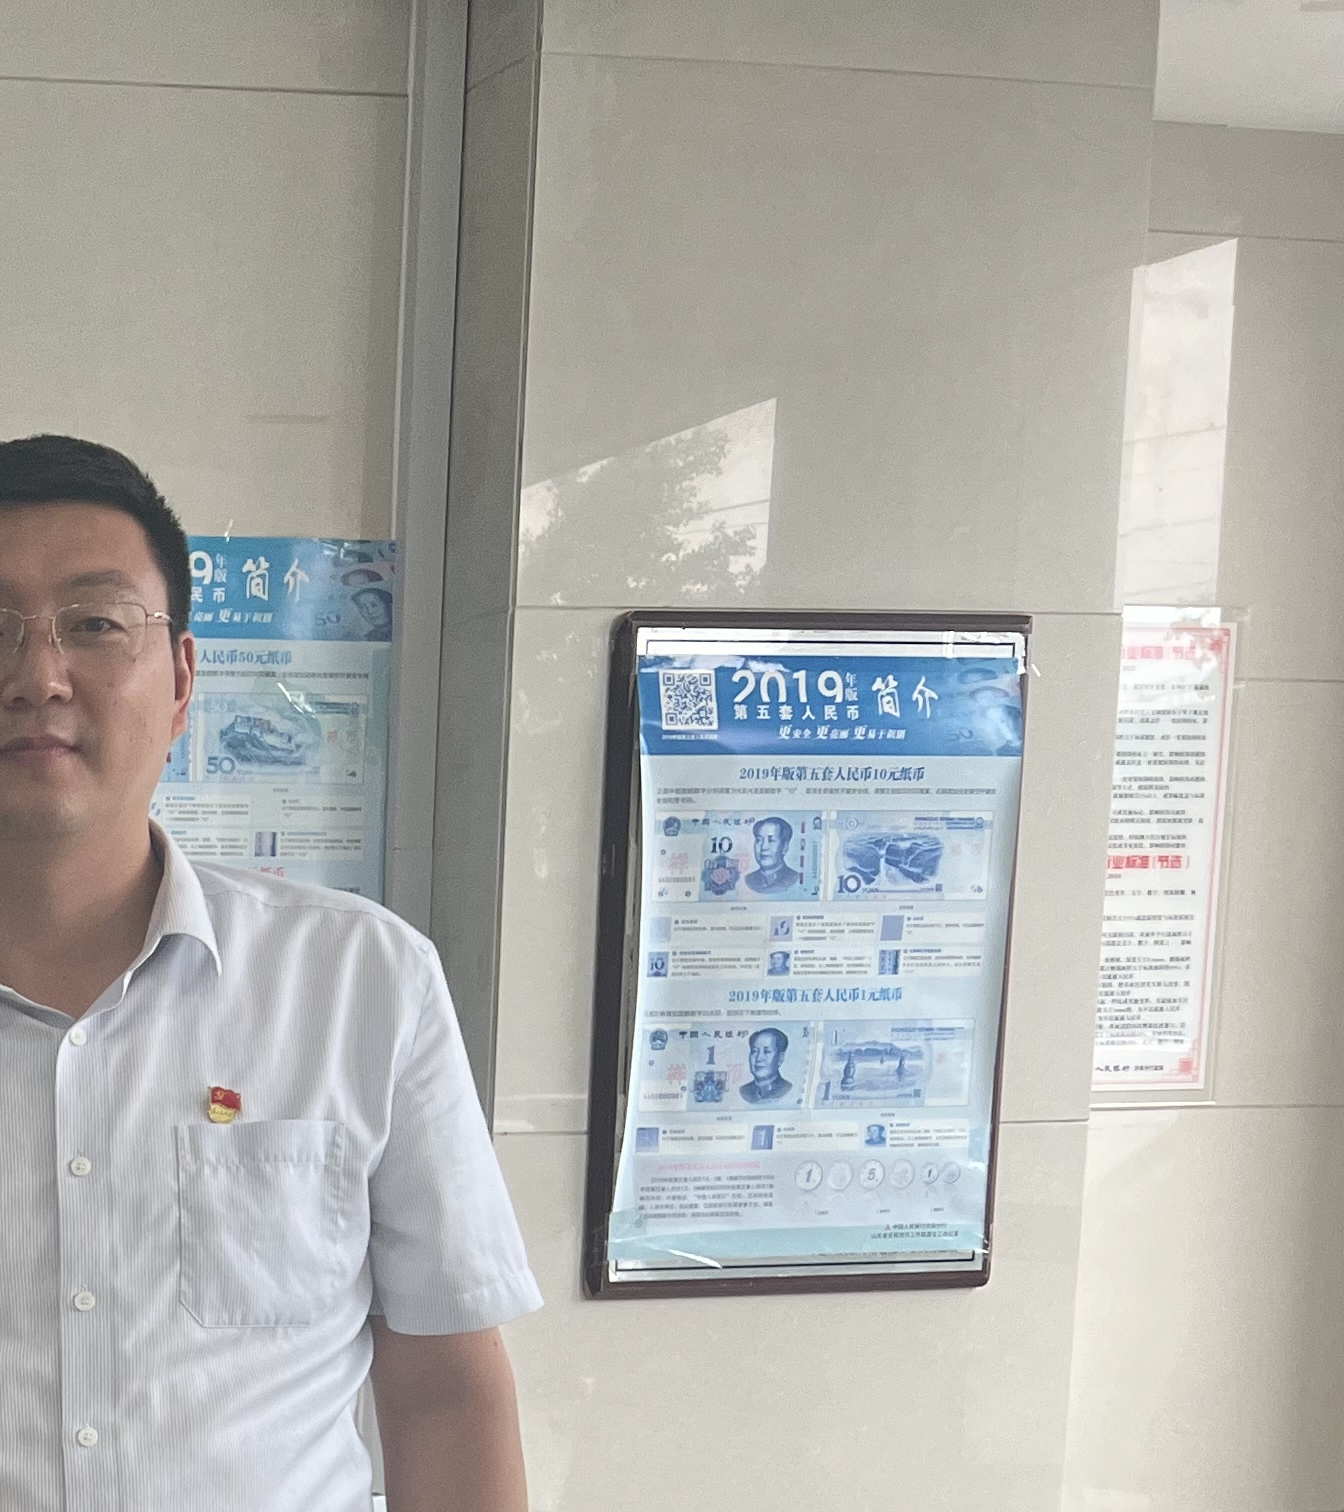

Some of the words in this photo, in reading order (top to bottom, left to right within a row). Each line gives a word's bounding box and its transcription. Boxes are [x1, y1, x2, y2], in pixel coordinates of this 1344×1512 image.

[189, 551, 212, 584] 9
[242, 556, 309, 604] 简介
[190, 587, 226, 603] 民币
[731, 670, 844, 703] 2019
[845, 672, 859, 701] 年版
[872, 674, 939, 718] 简介
[733, 704, 860, 721] 第五套人民币
[206, 756, 236, 774] 50
[739, 766, 925, 782] 2019年版第五套人民币10元纸币
[710, 837, 734, 854] 10
[837, 875, 861, 894] 10
[729, 987, 902, 1003] 2019年版第五套人民币1元纸币
